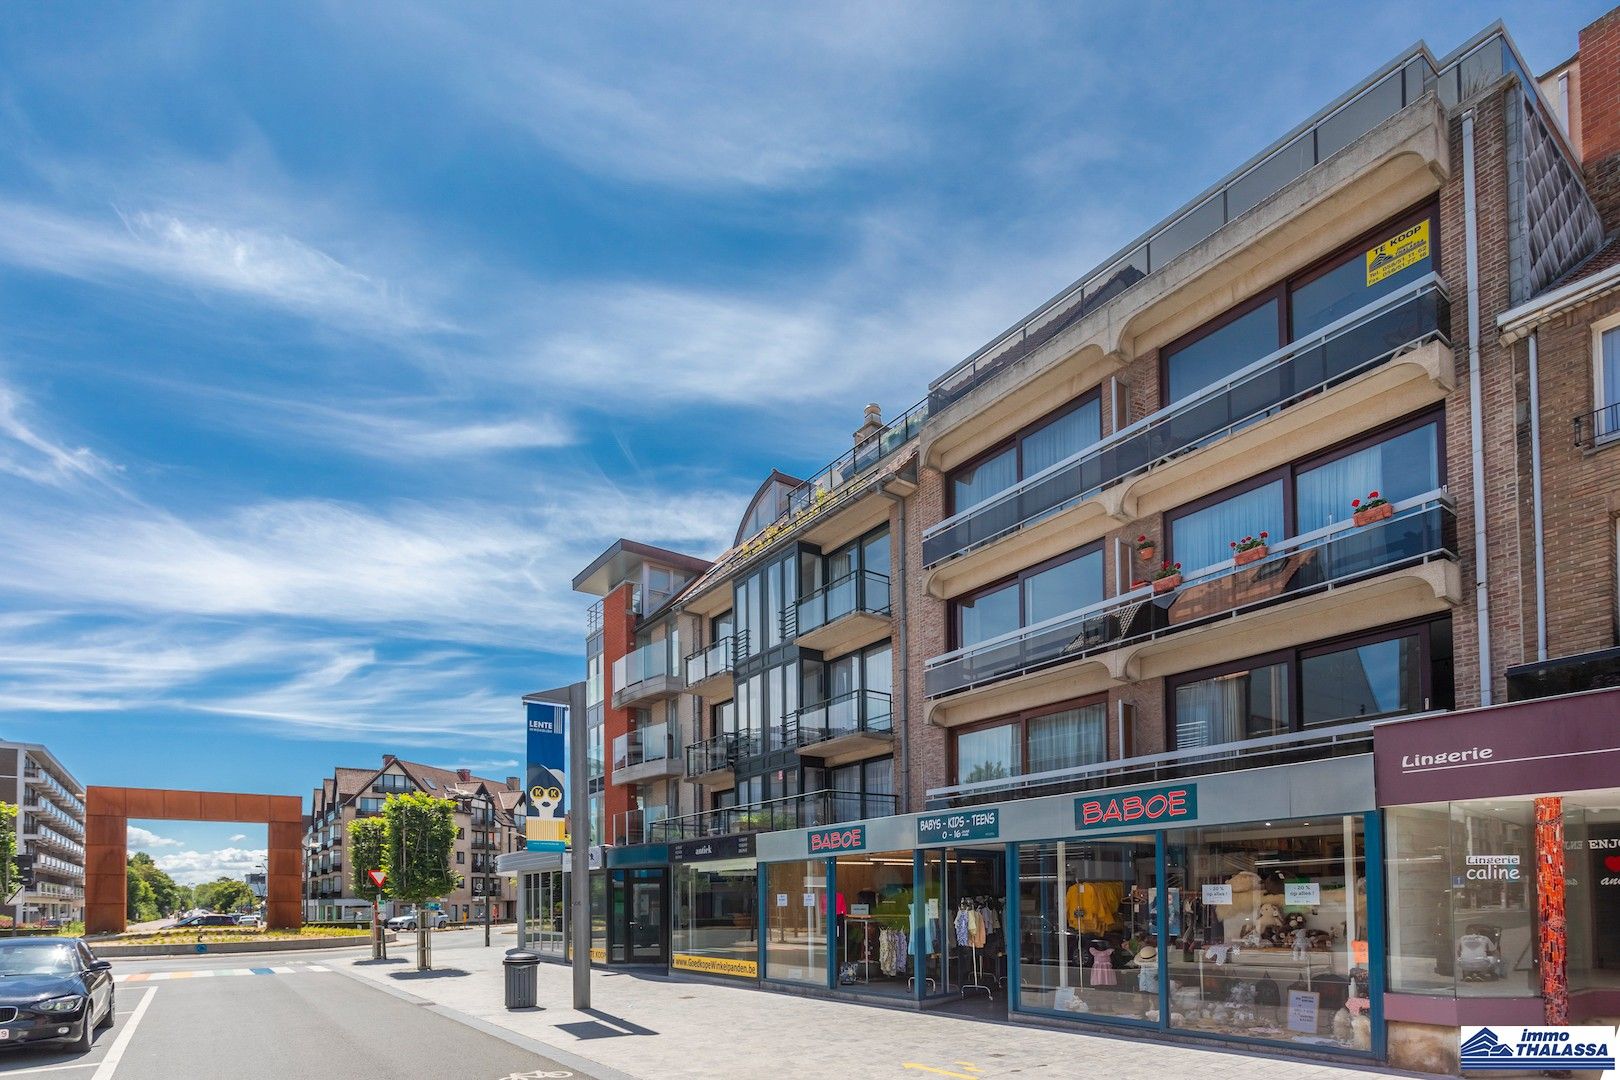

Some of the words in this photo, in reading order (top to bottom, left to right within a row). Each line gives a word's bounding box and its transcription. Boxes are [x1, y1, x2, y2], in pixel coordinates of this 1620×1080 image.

[1374, 245, 1386, 255] TE
[1390, 226, 1422, 246] KOOP
[529, 720, 553, 730] LENTE
[1402, 747, 1493, 768] Lingerie
[1082, 790, 1188, 826] BABOE
[920, 818, 941, 832] BABYS
[948, 816, 964, 828] KIDS
[971, 812, 995, 826] TEENS
[811, 829, 861, 851] BABOE
[954, 830, 961, 838] 16
[1588, 839, 1620, 850] ENJ
[1466, 864, 1520, 880] caline
[1600, 877, 1620, 886] an
